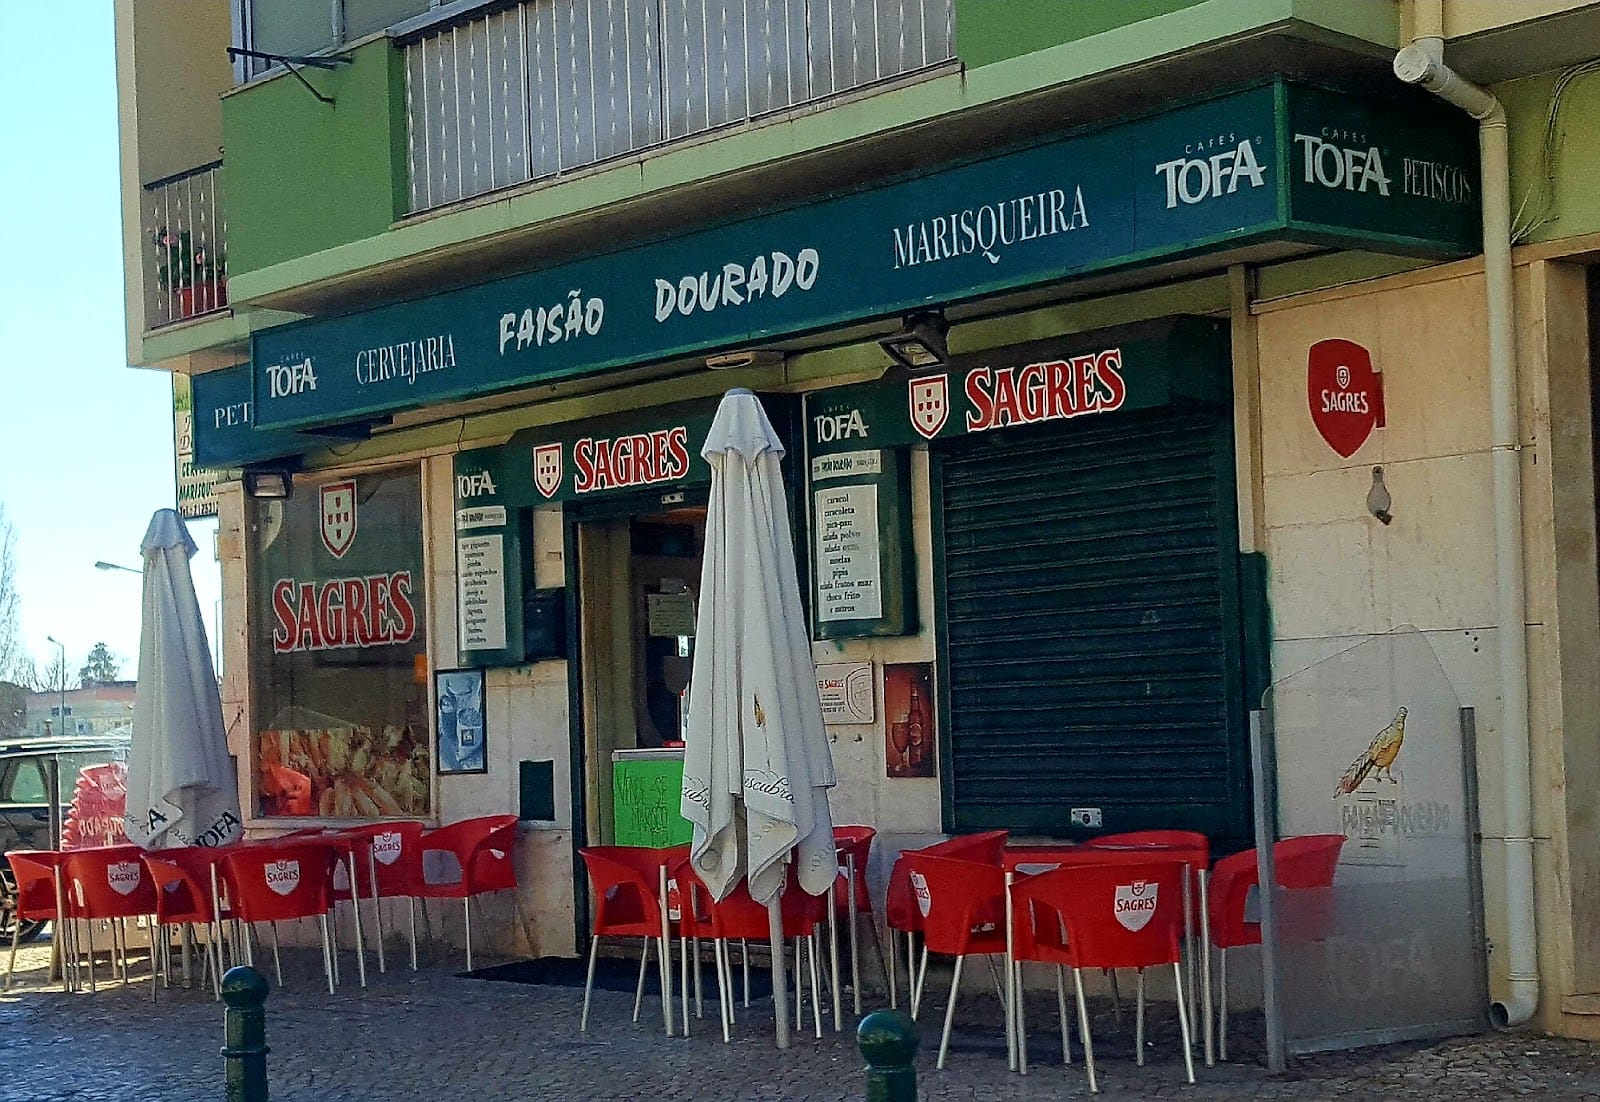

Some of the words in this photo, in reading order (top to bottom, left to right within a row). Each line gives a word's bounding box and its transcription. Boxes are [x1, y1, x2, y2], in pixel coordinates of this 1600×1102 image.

[1155, 138, 1267, 209] TOFA
[1294, 133, 1392, 197] TOFA
[893, 183, 1090, 270] MARISQUEIRA
[500, 288, 605, 356] FAISÃO
[655, 248, 819, 323] DOURADO
[266, 358, 318, 398] TOFA
[355, 333, 456, 384] CERVEJARIA
[965, 348, 1127, 433] SAGRES
[813, 408, 870, 443] TOFA
[1321, 389, 1369, 414] SAGRES
[574, 426, 690, 494] SAGRES
[272, 570, 416, 654] SAGRES
[267, 869, 299, 883] SAGRES
[1116, 896, 1155, 913] SAGRES
